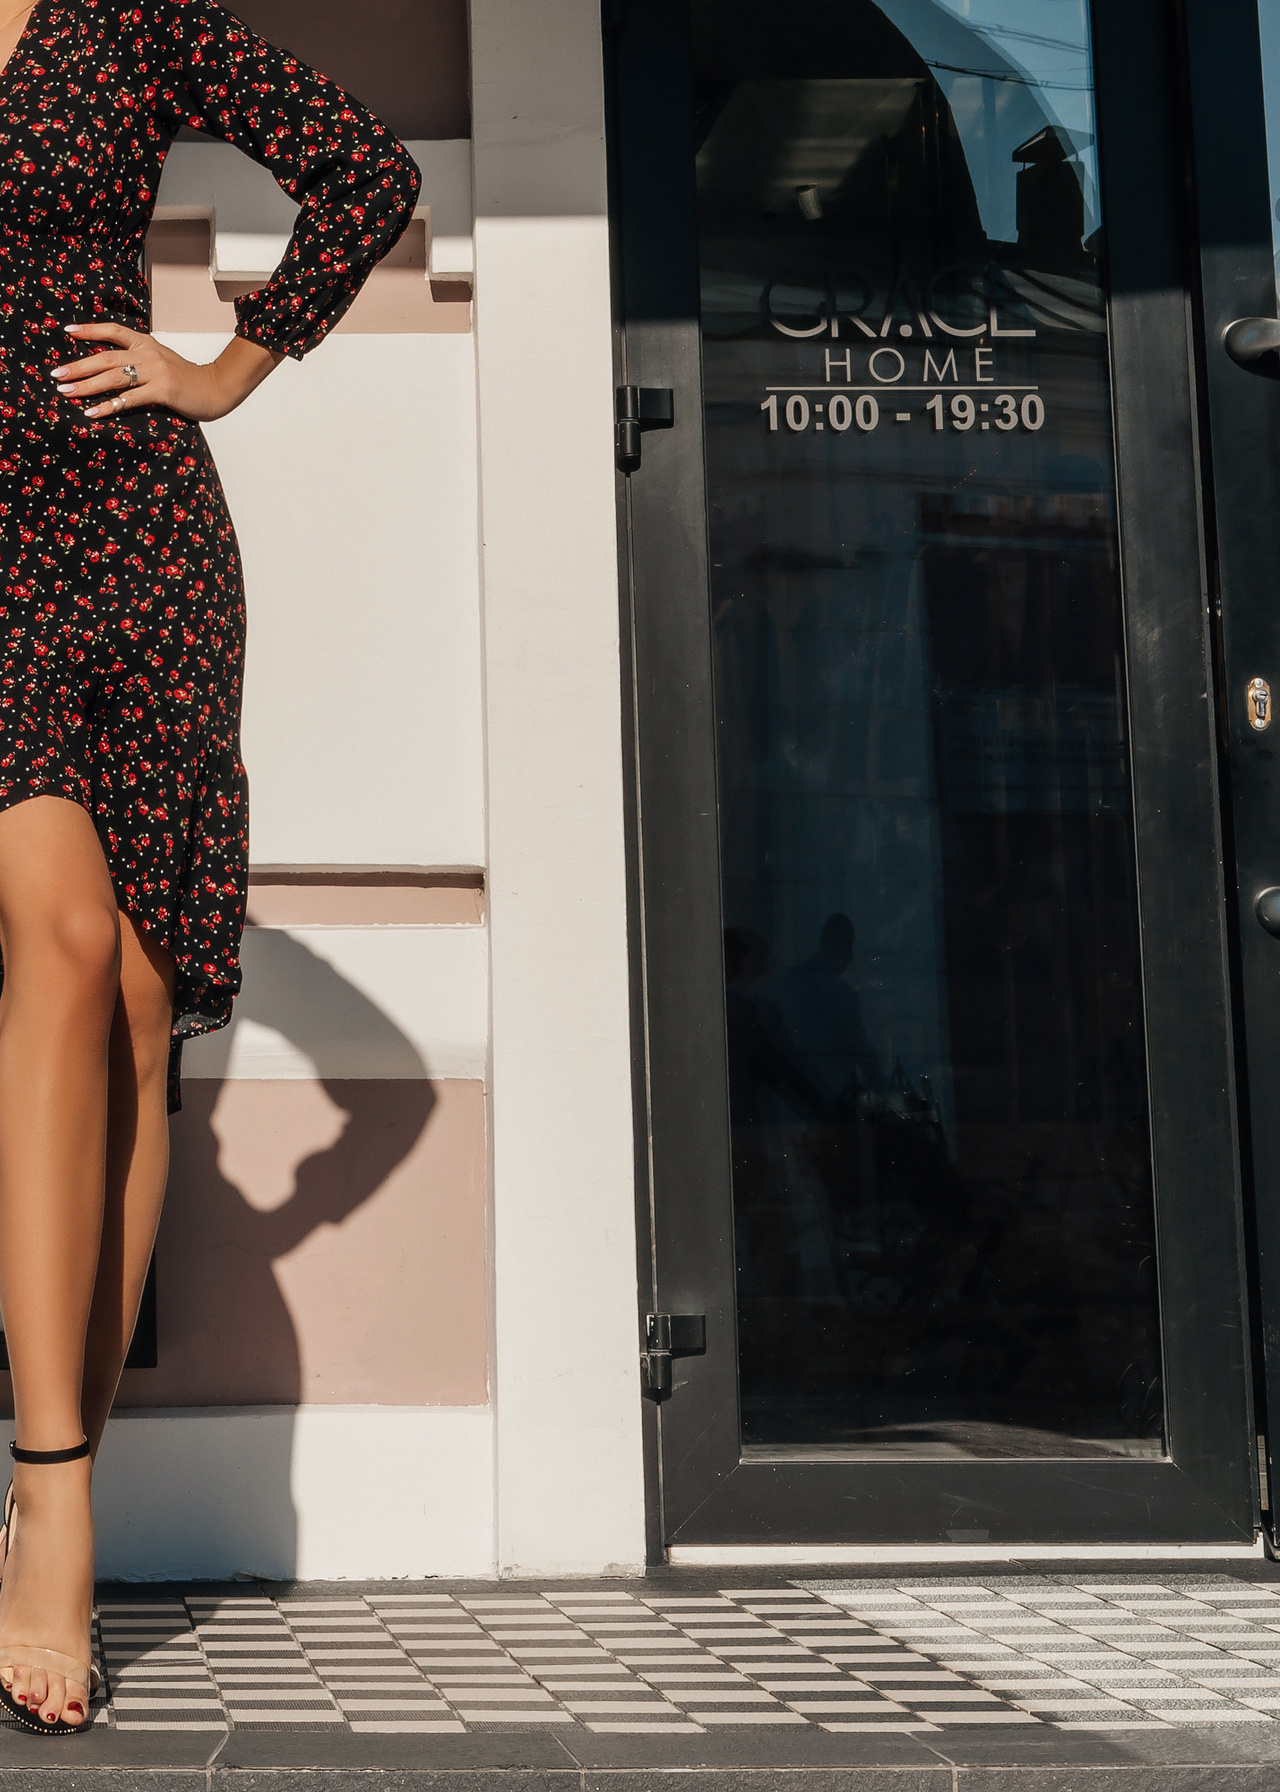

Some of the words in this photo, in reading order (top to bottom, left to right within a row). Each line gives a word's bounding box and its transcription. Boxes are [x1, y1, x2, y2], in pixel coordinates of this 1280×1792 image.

[759, 262, 1036, 338] GRACE
[824, 347, 995, 383] HOME
[760, 394, 880, 431] 10:00
[896, 412, 911, 421] -
[926, 394, 1046, 431] 19:30
